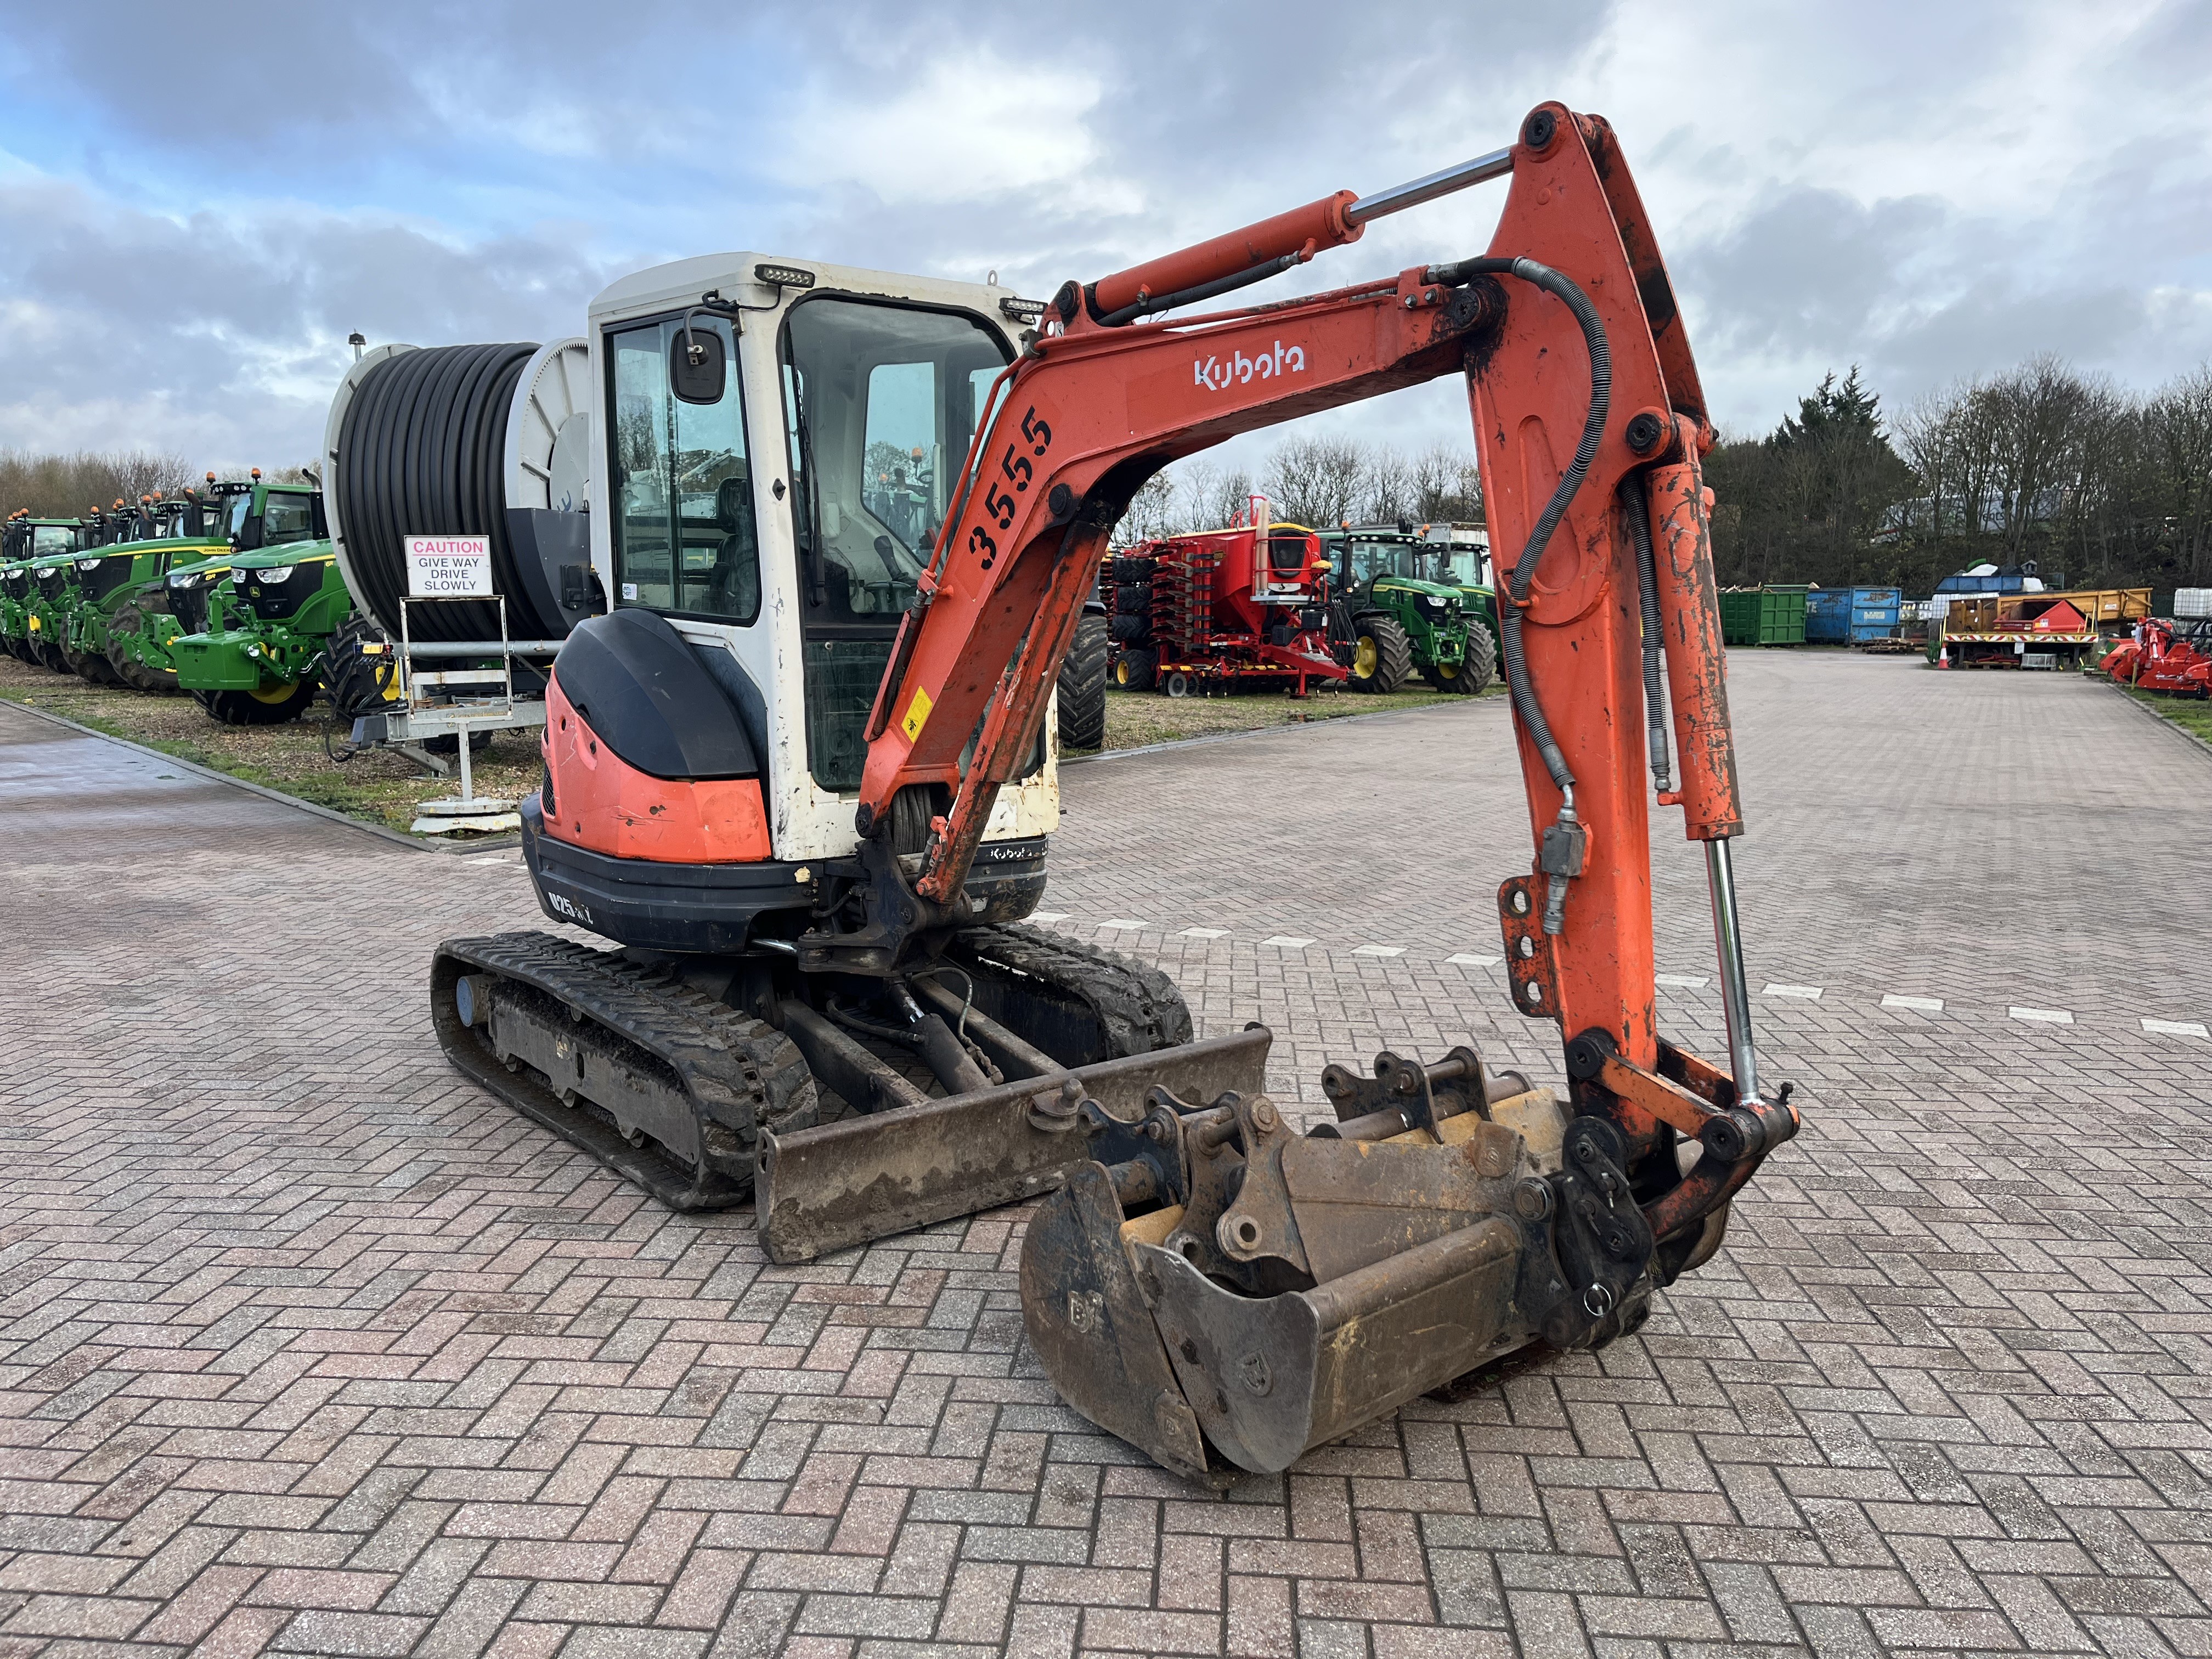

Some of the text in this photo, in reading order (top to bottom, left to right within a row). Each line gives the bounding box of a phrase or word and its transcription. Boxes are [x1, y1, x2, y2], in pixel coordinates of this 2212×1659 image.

[1194, 340, 1304, 391] Kubota
[969, 405, 1051, 569] 3555
[414, 541, 483, 553] CAUTION
[419, 558, 479, 567] GIVE WAY
[431, 569, 469, 579] DRIVE
[425, 581, 476, 590] SLOWLY
[1806, 601, 1817, 613] TE
